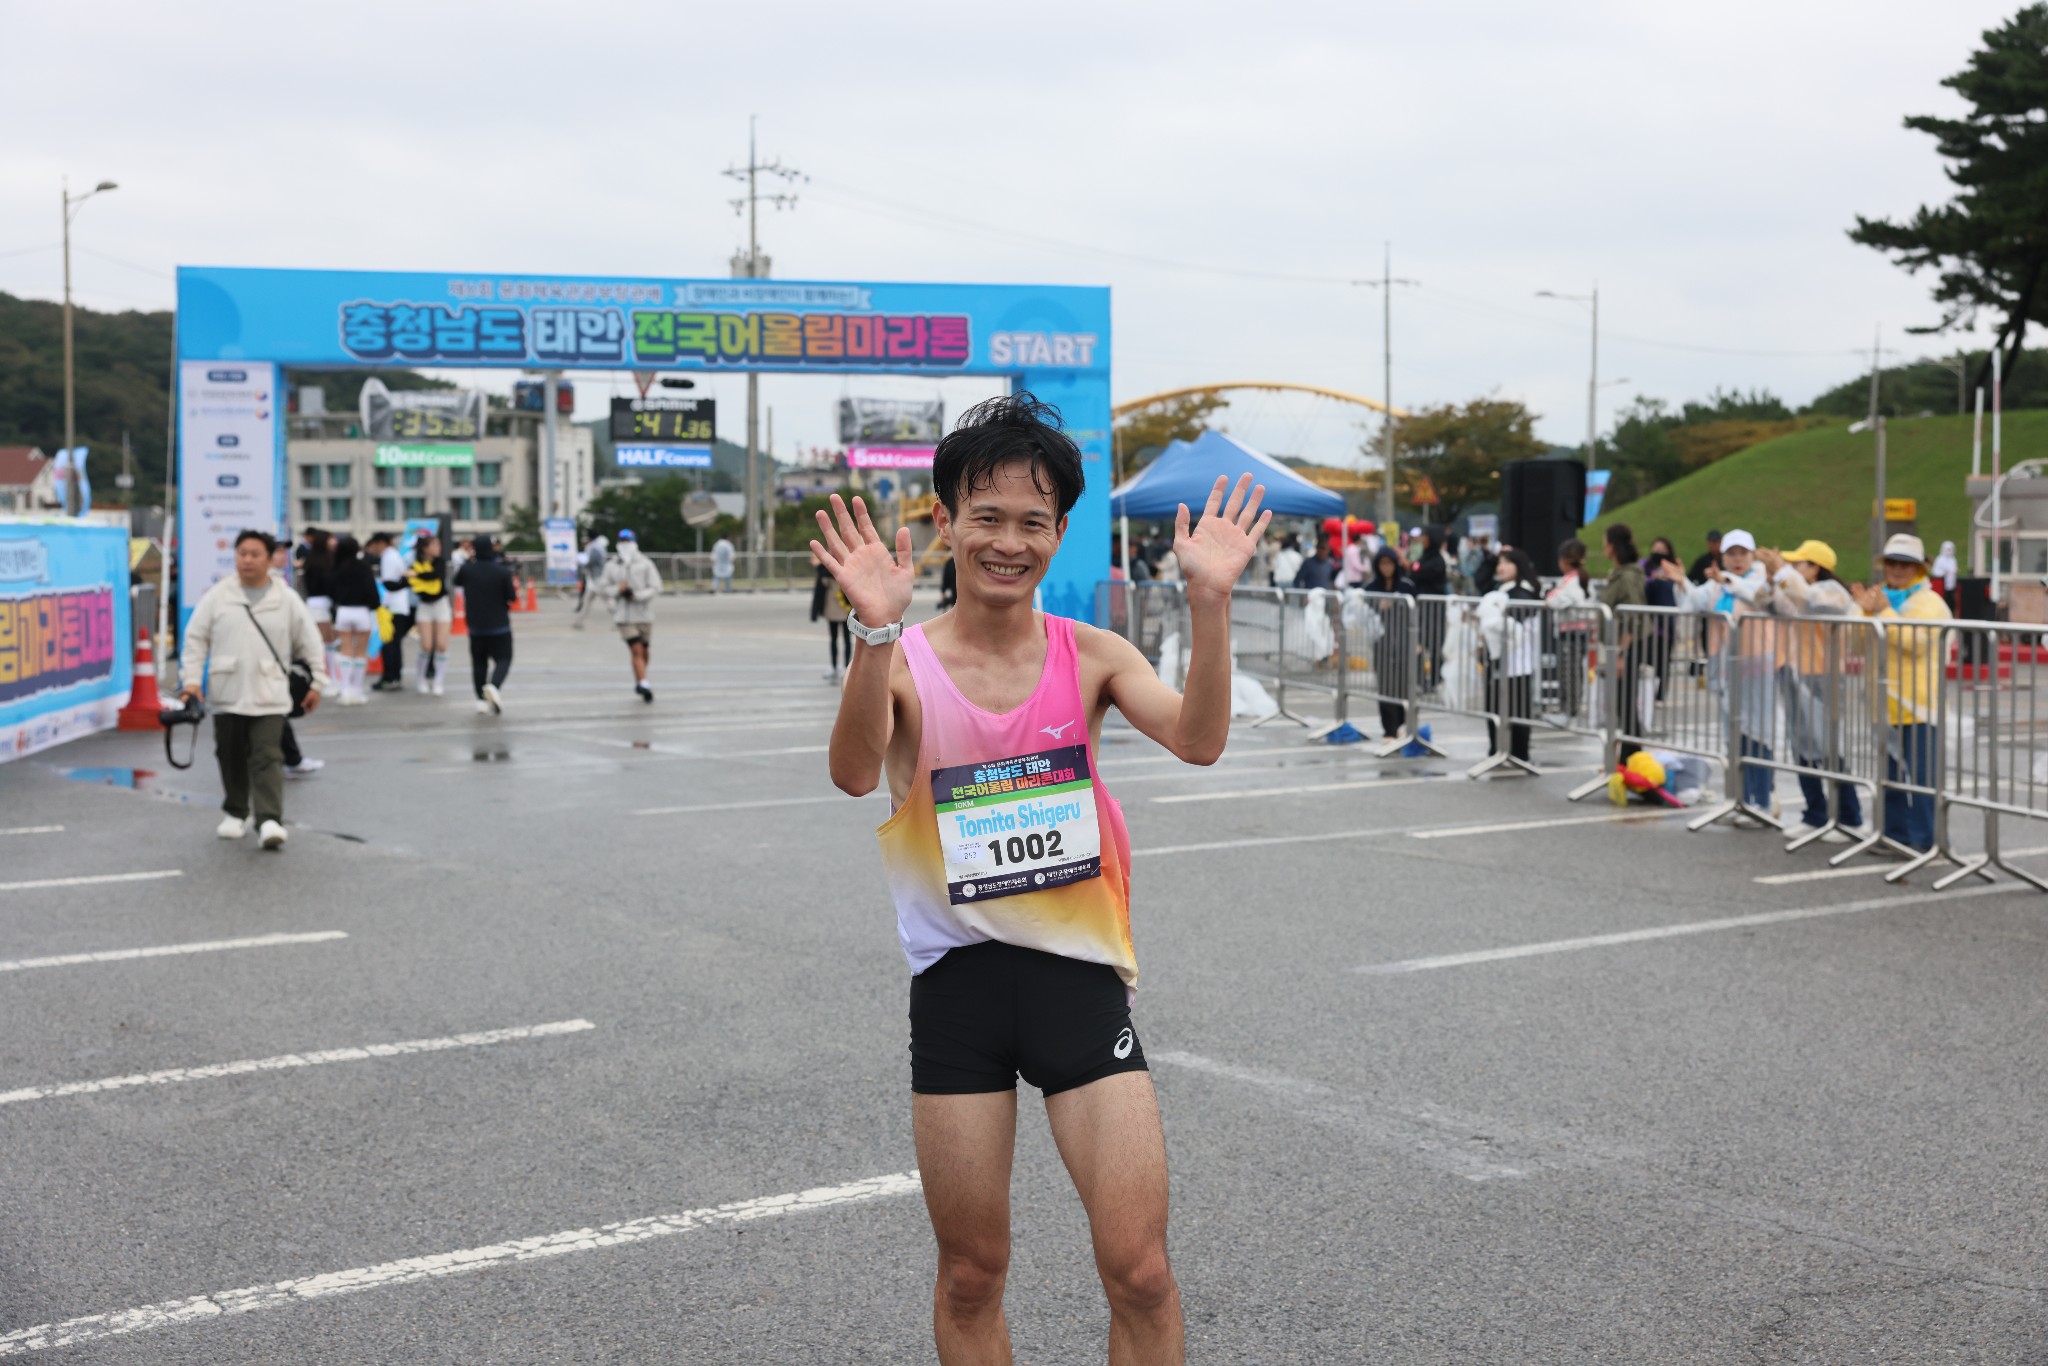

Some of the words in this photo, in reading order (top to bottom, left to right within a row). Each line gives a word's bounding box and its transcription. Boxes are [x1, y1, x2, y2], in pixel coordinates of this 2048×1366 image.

[343, 304, 525, 357] 충청남도
[532, 309, 625, 360] 태안
[990, 333, 1097, 367] START
[617, 449, 665, 466] HALF
[664, 452, 712, 467] Course
[951, 778, 1014, 800] 전국어울림
[1015, 767, 1075, 789] 마라톤대회
[973, 763, 1023, 783] 충청남도
[1025, 758, 1051, 774] 태안
[954, 800, 975, 809] 10KM
[955, 809, 1016, 838] Tomita
[1017, 801, 1081, 829] Shigeru
[987, 830, 1064, 866] 1002
